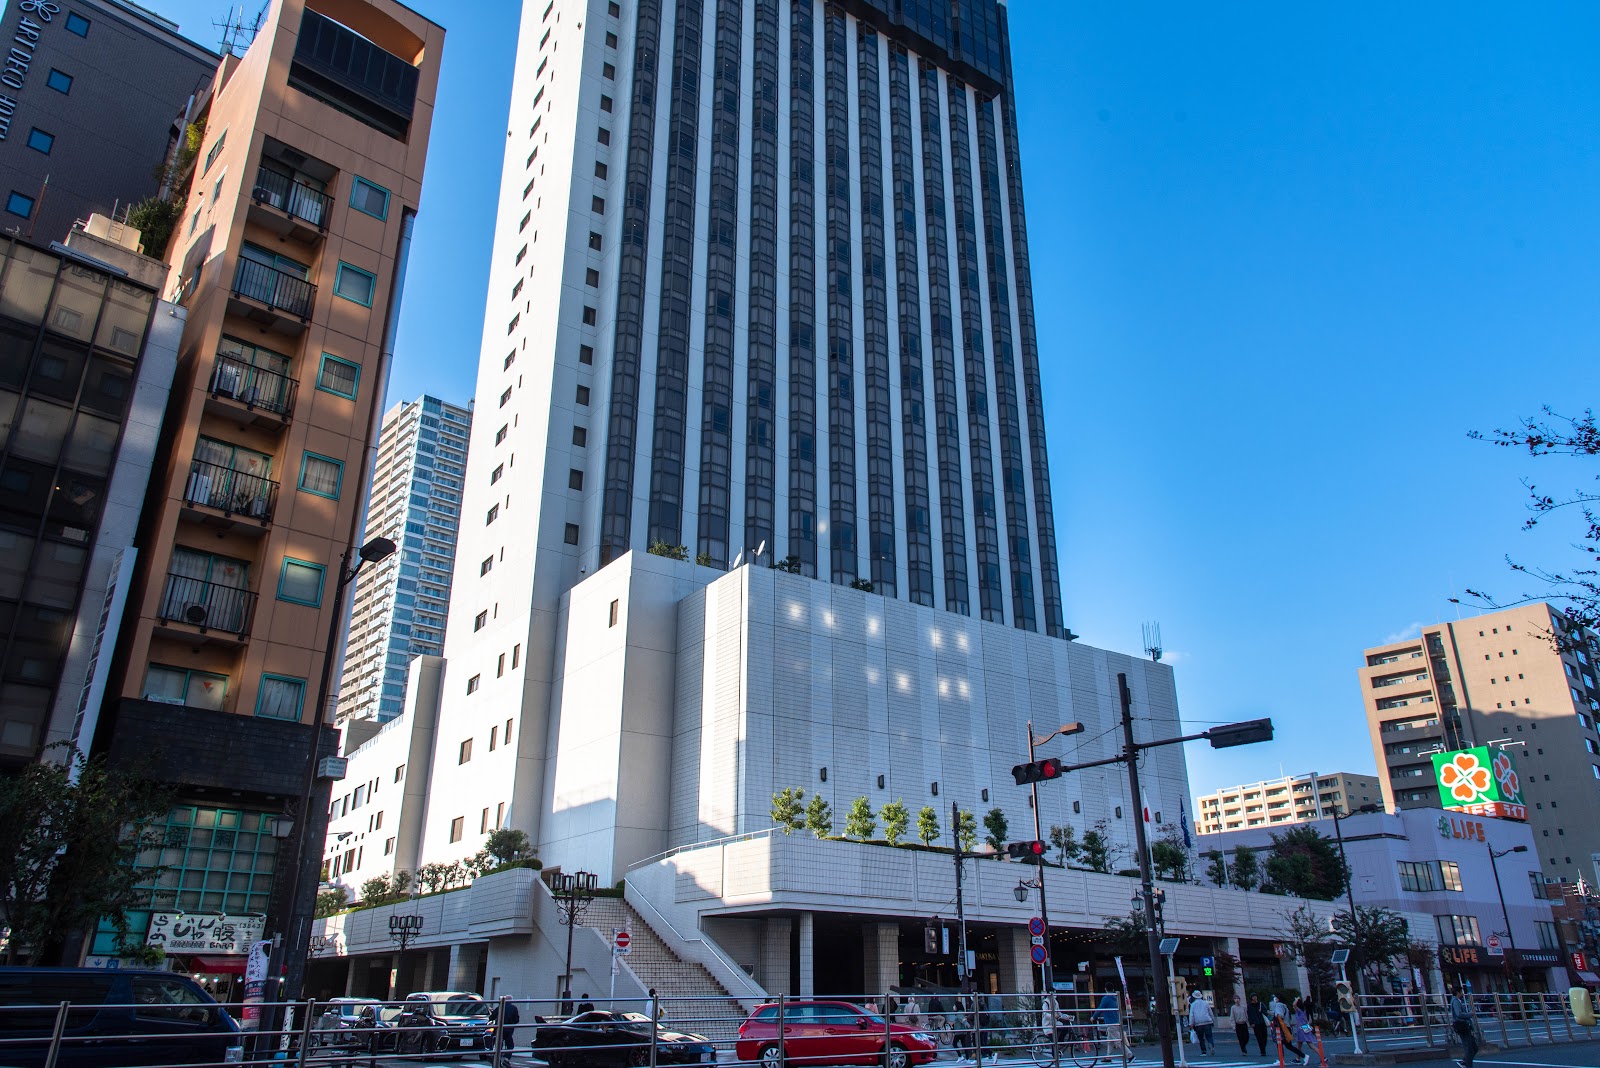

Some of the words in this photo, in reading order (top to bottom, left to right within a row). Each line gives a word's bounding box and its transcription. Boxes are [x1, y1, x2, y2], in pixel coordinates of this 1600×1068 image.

[15, 15, 41, 51] ART
[1, 47, 33, 89] DECO
[0, 93, 17, 140] HOT
[1502, 803, 1525, 819] ライフ
[1450, 818, 1486, 842] LIFE
[1202, 957, 1211, 967] P
[1451, 948, 1479, 964] LIFE
[1521, 954, 1559, 963] SUPERMARKET
